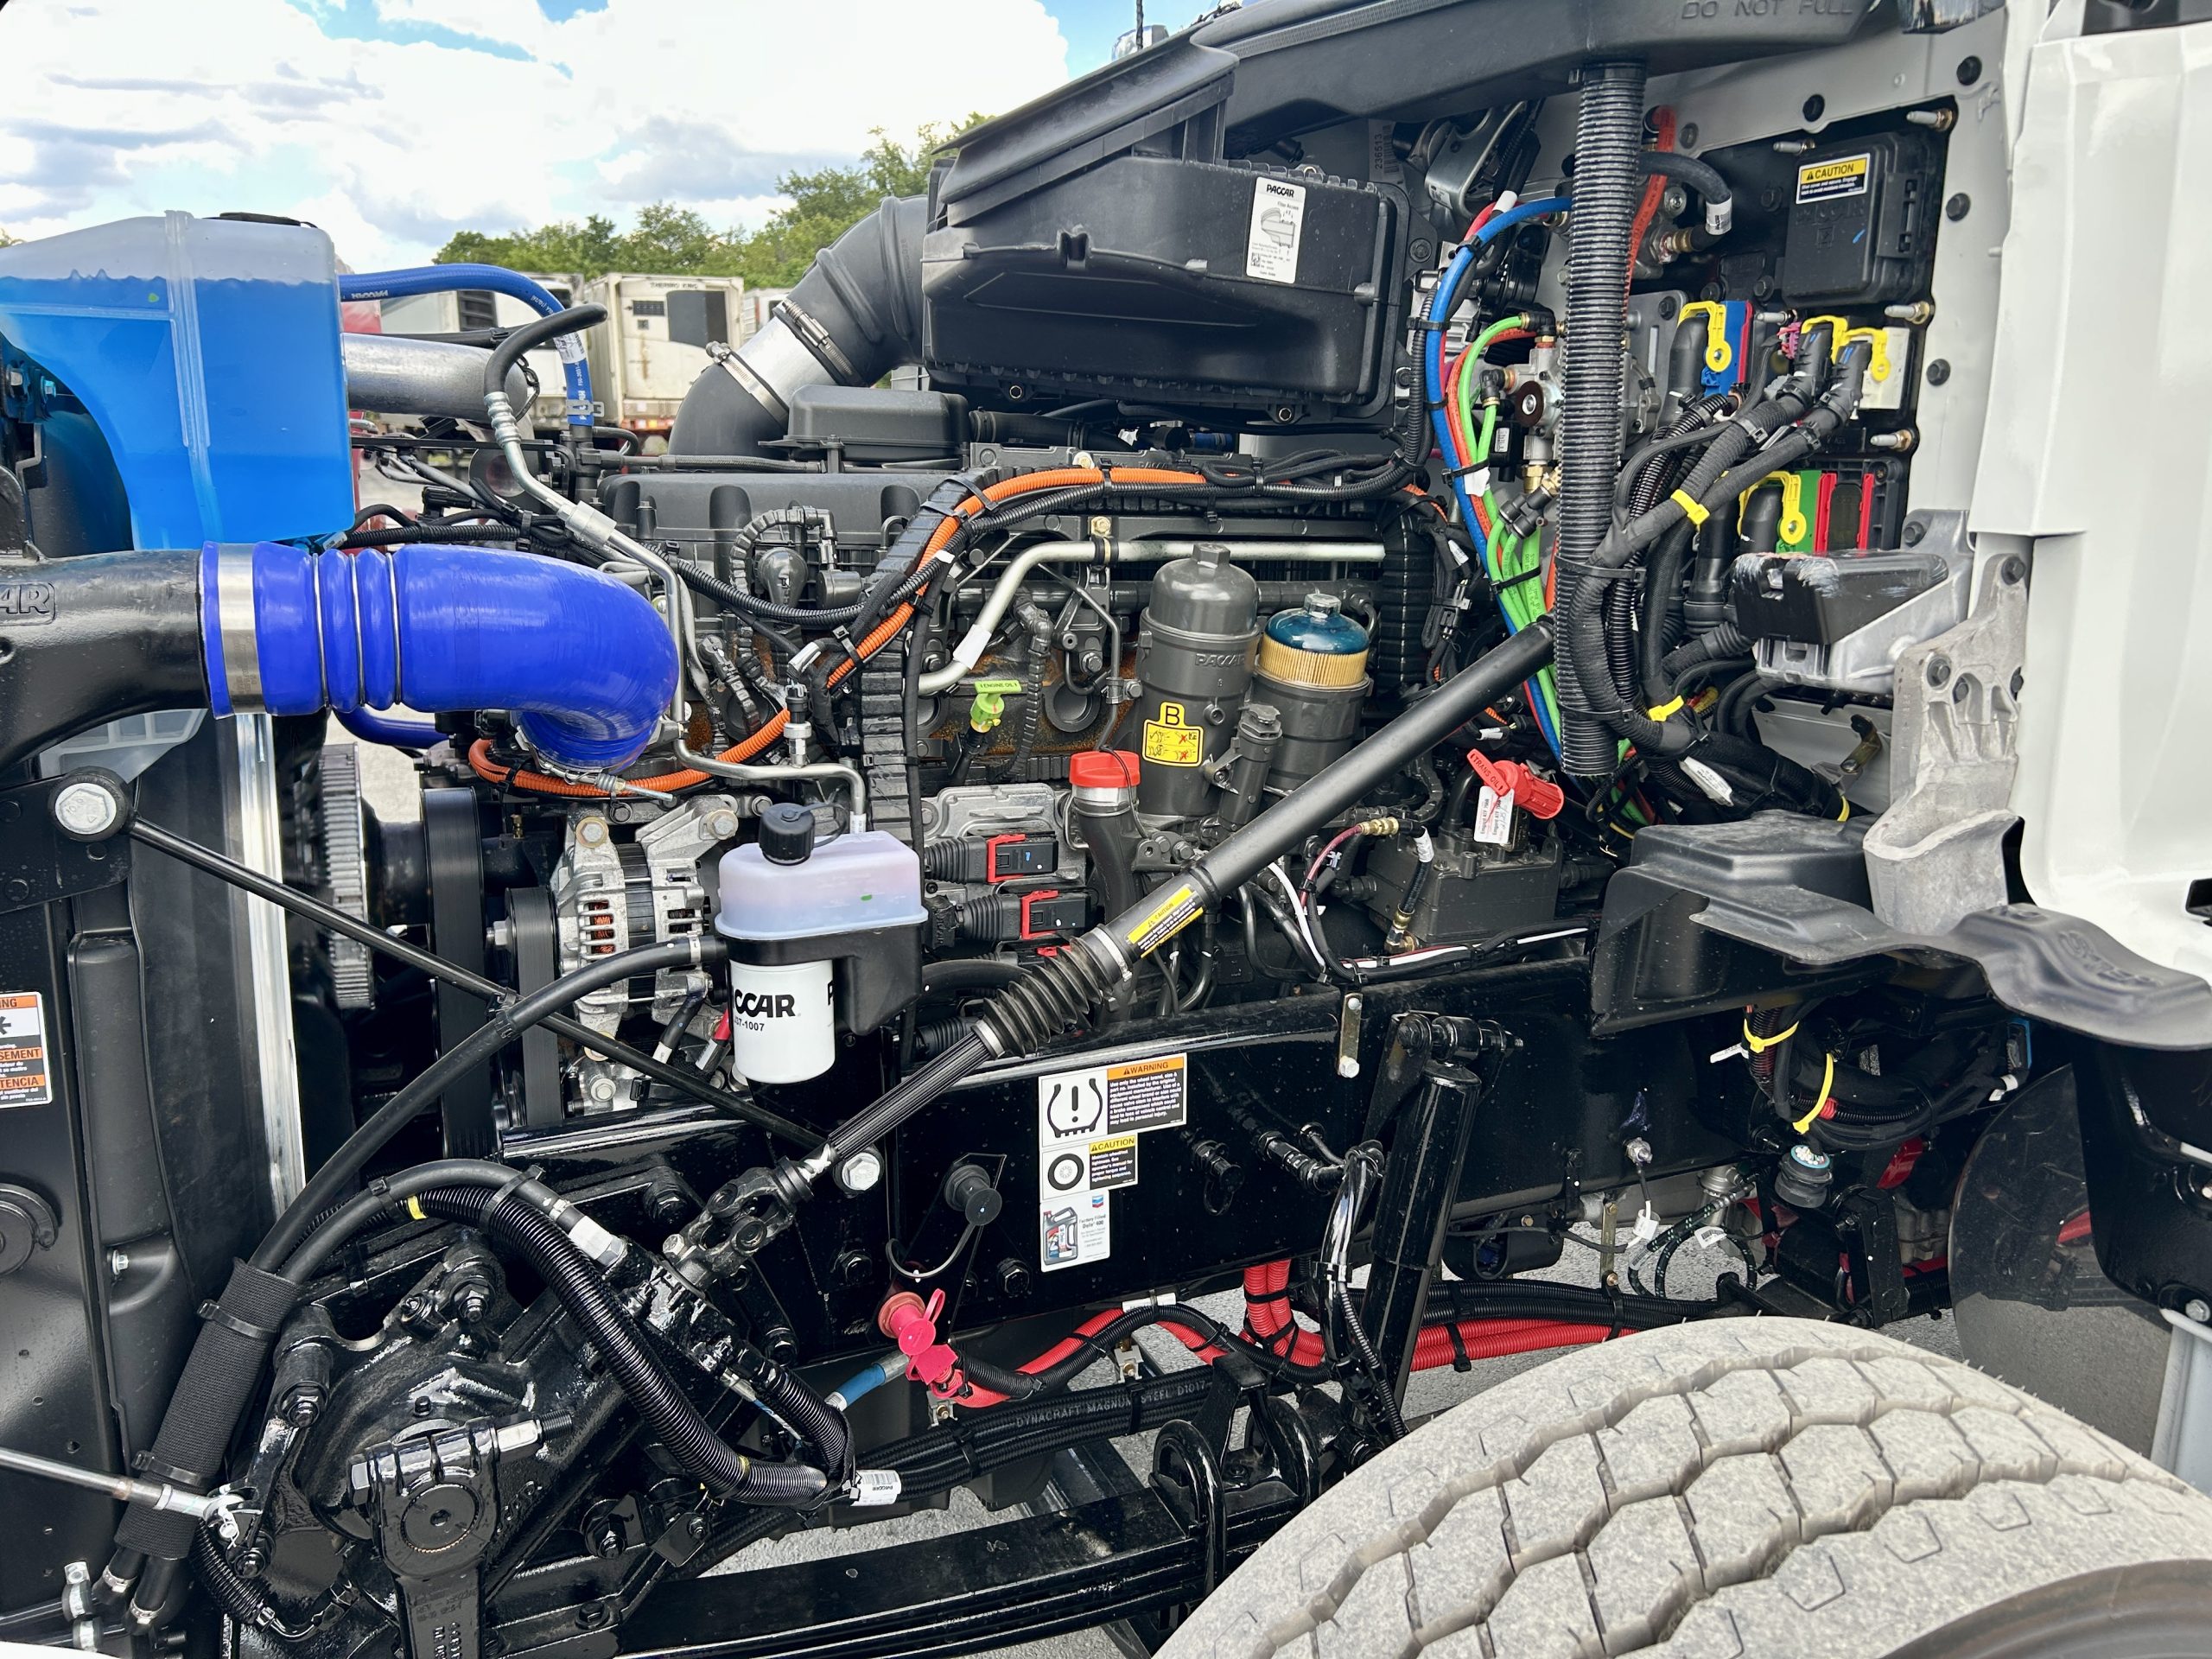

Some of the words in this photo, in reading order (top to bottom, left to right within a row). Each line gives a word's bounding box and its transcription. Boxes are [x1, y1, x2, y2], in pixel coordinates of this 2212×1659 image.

[1682, 2, 1717, 19] DO
[1734, 0, 1783, 16] NOT
[1799, 0, 1853, 14] PULL
[1815, 164, 1853, 179] CAUTION
[1267, 184, 1294, 198] PACCAR
[1166, 705, 1180, 725] B
[1474, 757, 1491, 776] TRANS
[1491, 776, 1500, 788] OIL
[1155, 902, 1173, 918] CAUTION
[1130, 1062, 1168, 1075] WARNING
[1098, 1138, 1134, 1150] CAUTION
[1016, 1406, 1080, 1427] DYNACRAFT
[1141, 1390, 1170, 1404] STEEL
